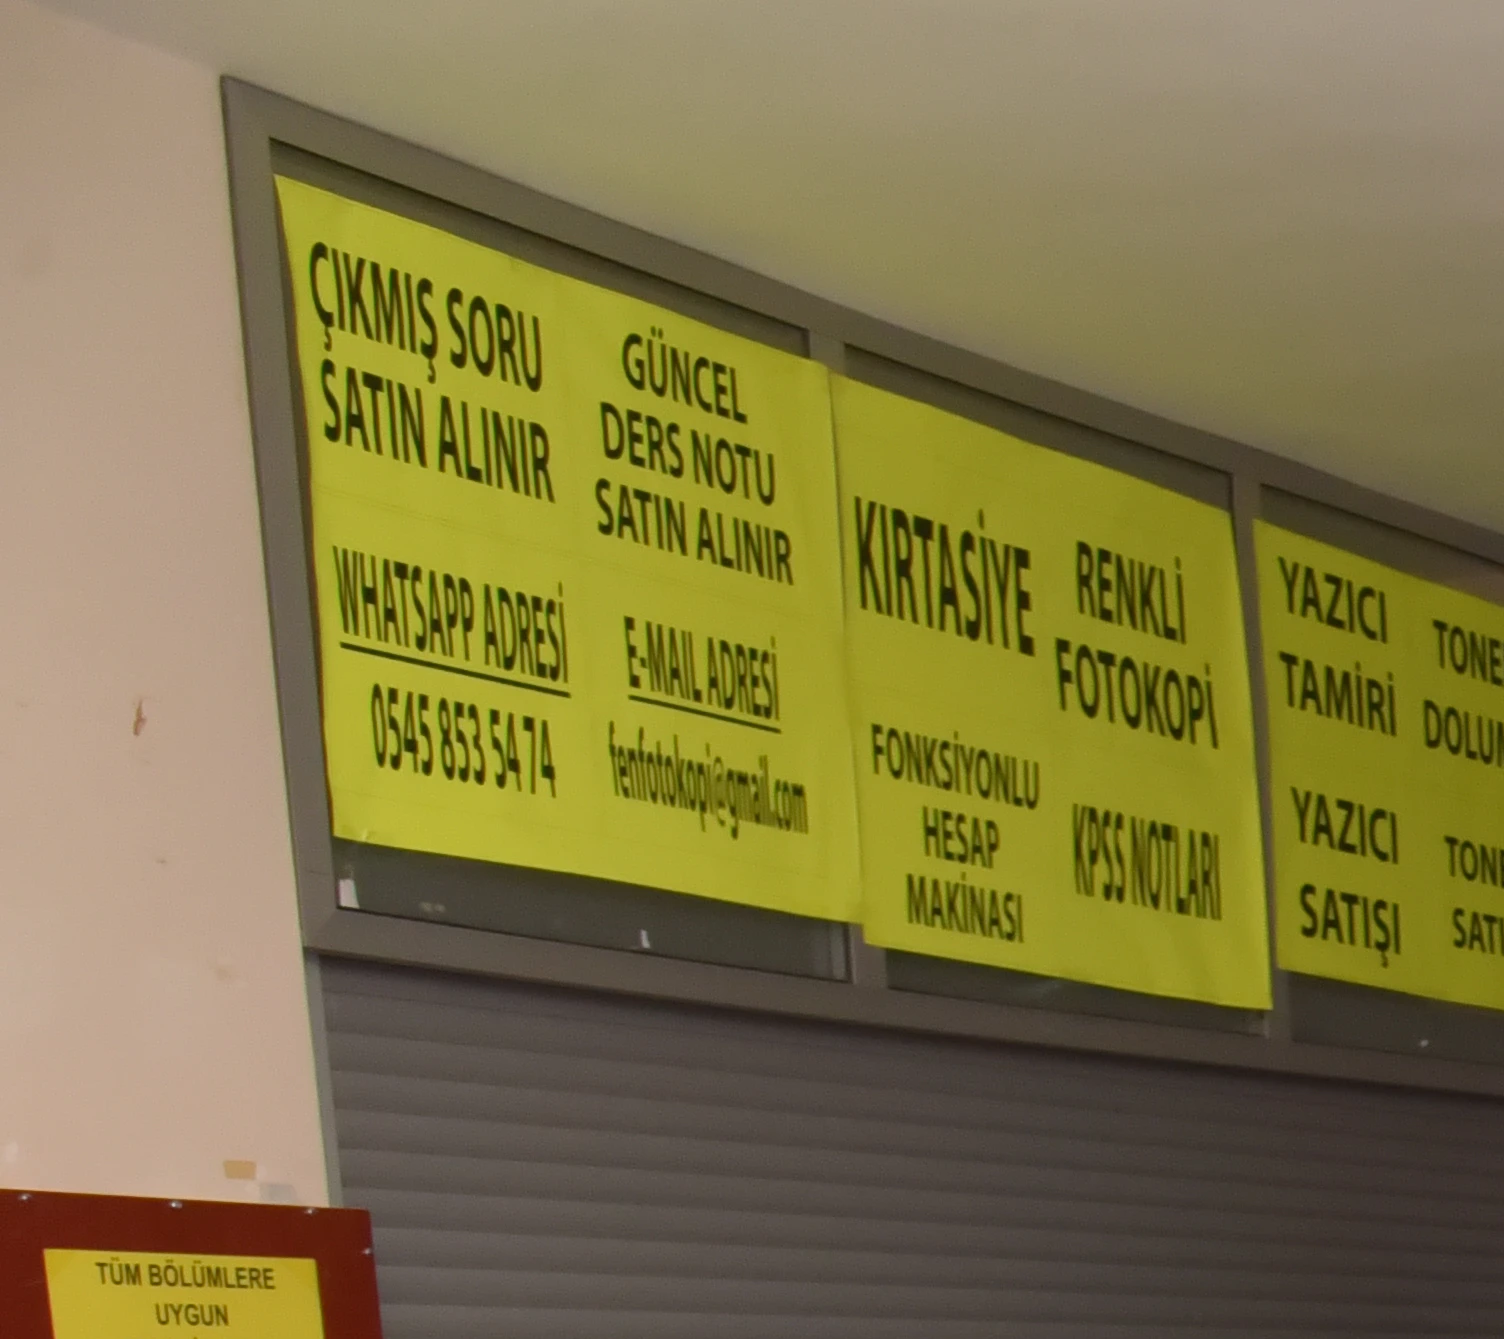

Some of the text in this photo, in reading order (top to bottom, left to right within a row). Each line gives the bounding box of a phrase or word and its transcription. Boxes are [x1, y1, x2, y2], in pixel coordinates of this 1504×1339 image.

[309, 240, 545, 393] ÇIKMIŞ SORU
[621, 326, 748, 424] GÜNCEL
[319, 359, 556, 504] SATIN ALINIR
[600, 402, 776, 507] DERS NOTU
[594, 477, 796, 587] SATIN ALINIR
[853, 495, 1035, 657] KIRTASİYE
[332, 545, 569, 684] WHATSAPP ADRESİ
[1075, 540, 1187, 645] RENKLİ
[1277, 555, 1389, 644] YAZICI
[623, 615, 781, 722] E-MAIL ADRESİ
[1055, 637, 1219, 750] FOTOKOPİ
[1278, 650, 1398, 738] TAMİRİ
[370, 683, 434, 777] 0545
[438, 697, 486, 786] 853
[608, 720, 809, 841] fenfotokopi@gmail.com
[870, 722, 1041, 810] FONKSİYONLU
[922, 805, 1000, 870] HESAP
[1071, 802, 1223, 921] KPSS NOTLARI
[1290, 786, 1399, 866] YAZICI
[906, 871, 1024, 944] MAKİNASI
[1299, 883, 1401, 968] SATIŞI
[94, 1257, 276, 1291] TÜM BÖLÜMLERE
[155, 1302, 230, 1327] UYGUN
